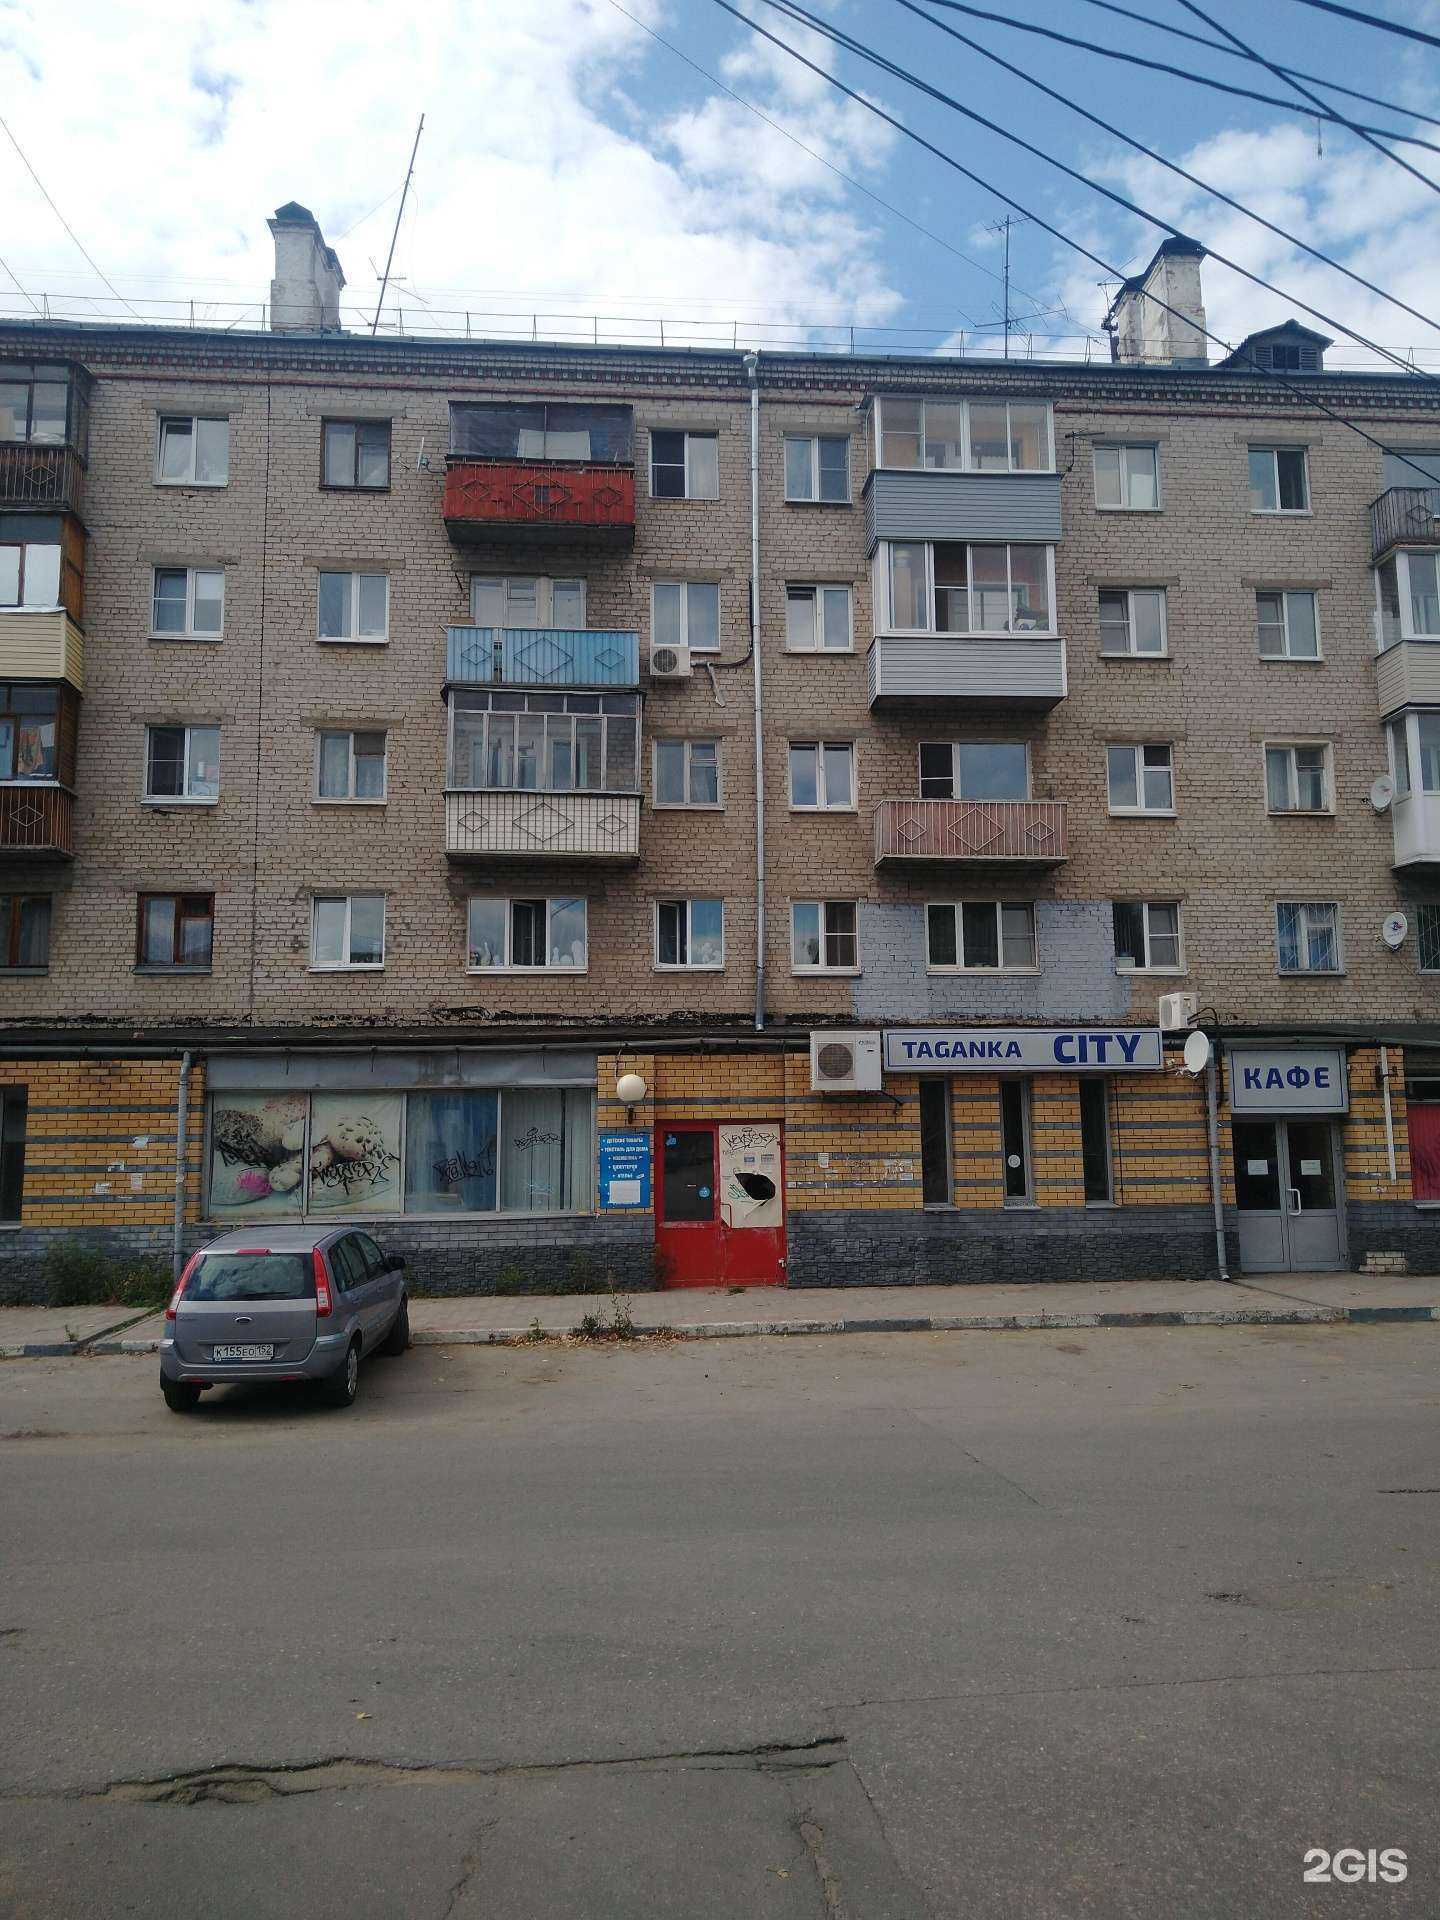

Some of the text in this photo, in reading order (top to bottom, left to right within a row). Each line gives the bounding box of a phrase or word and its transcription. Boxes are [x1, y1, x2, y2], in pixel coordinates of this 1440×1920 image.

[902, 1034, 1142, 1064] TAGANKA CITY
[1243, 1065, 1331, 1090] КАФЕ
